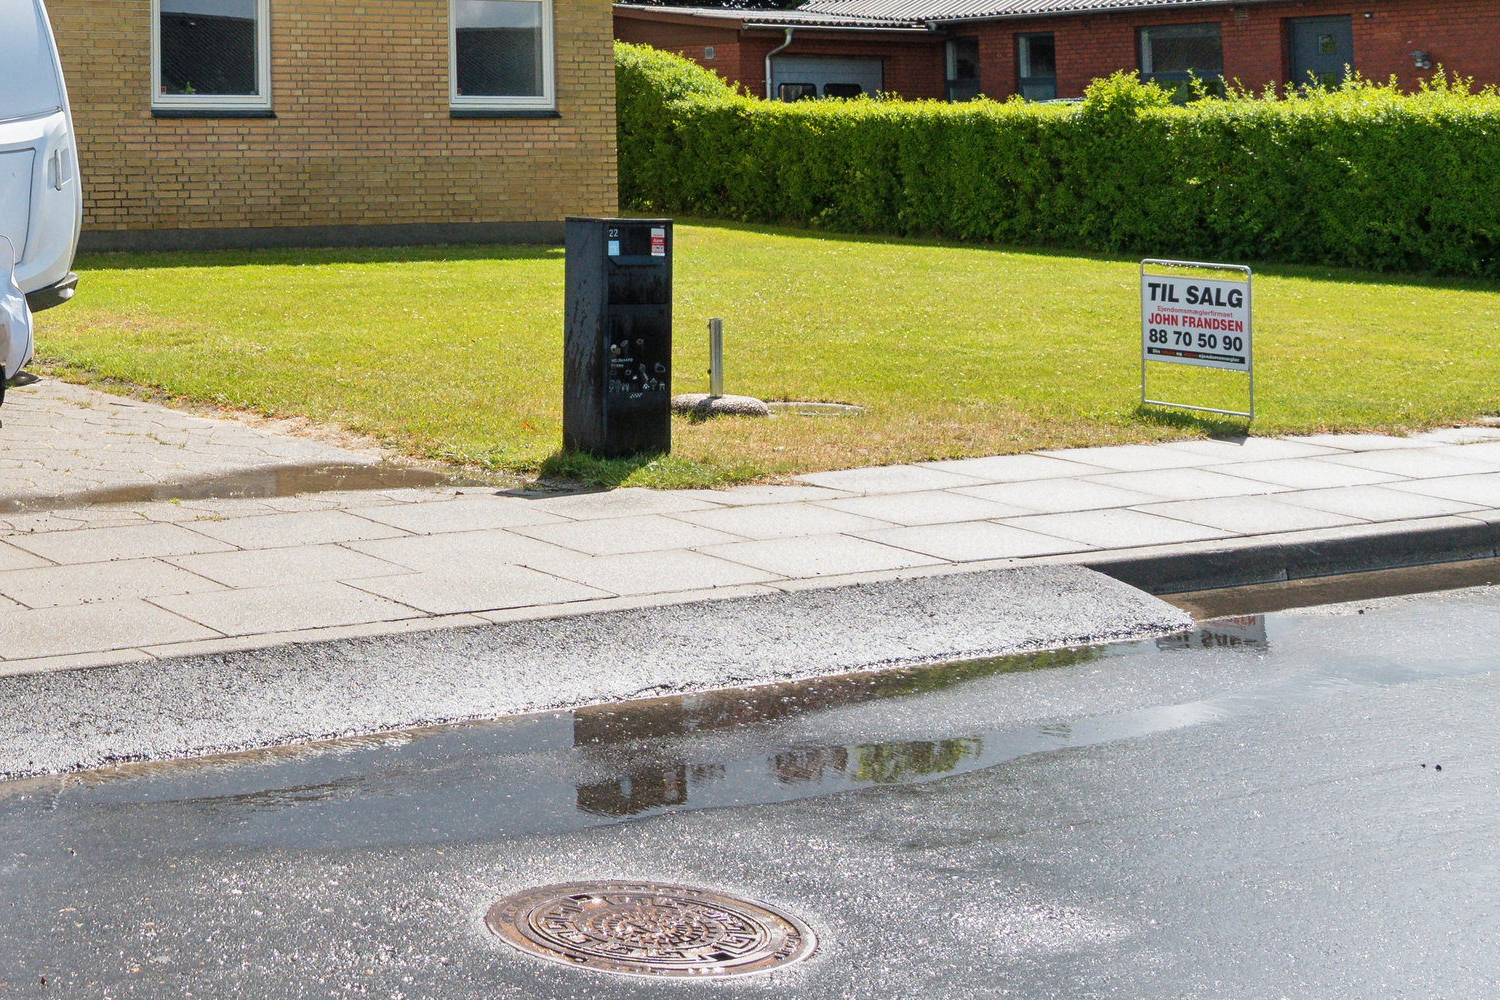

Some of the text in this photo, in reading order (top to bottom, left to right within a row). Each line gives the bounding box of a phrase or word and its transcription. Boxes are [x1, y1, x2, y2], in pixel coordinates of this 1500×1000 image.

[609, 228, 619, 238] 22
[1148, 282, 1243, 309] TIL SALG
[1157, 305, 1233, 318] Ejendomsmæglerfirmaet
[1148, 312, 1243, 332] JOHN FRANDSEN
[1149, 328, 1243, 352] 88 70 50 90
